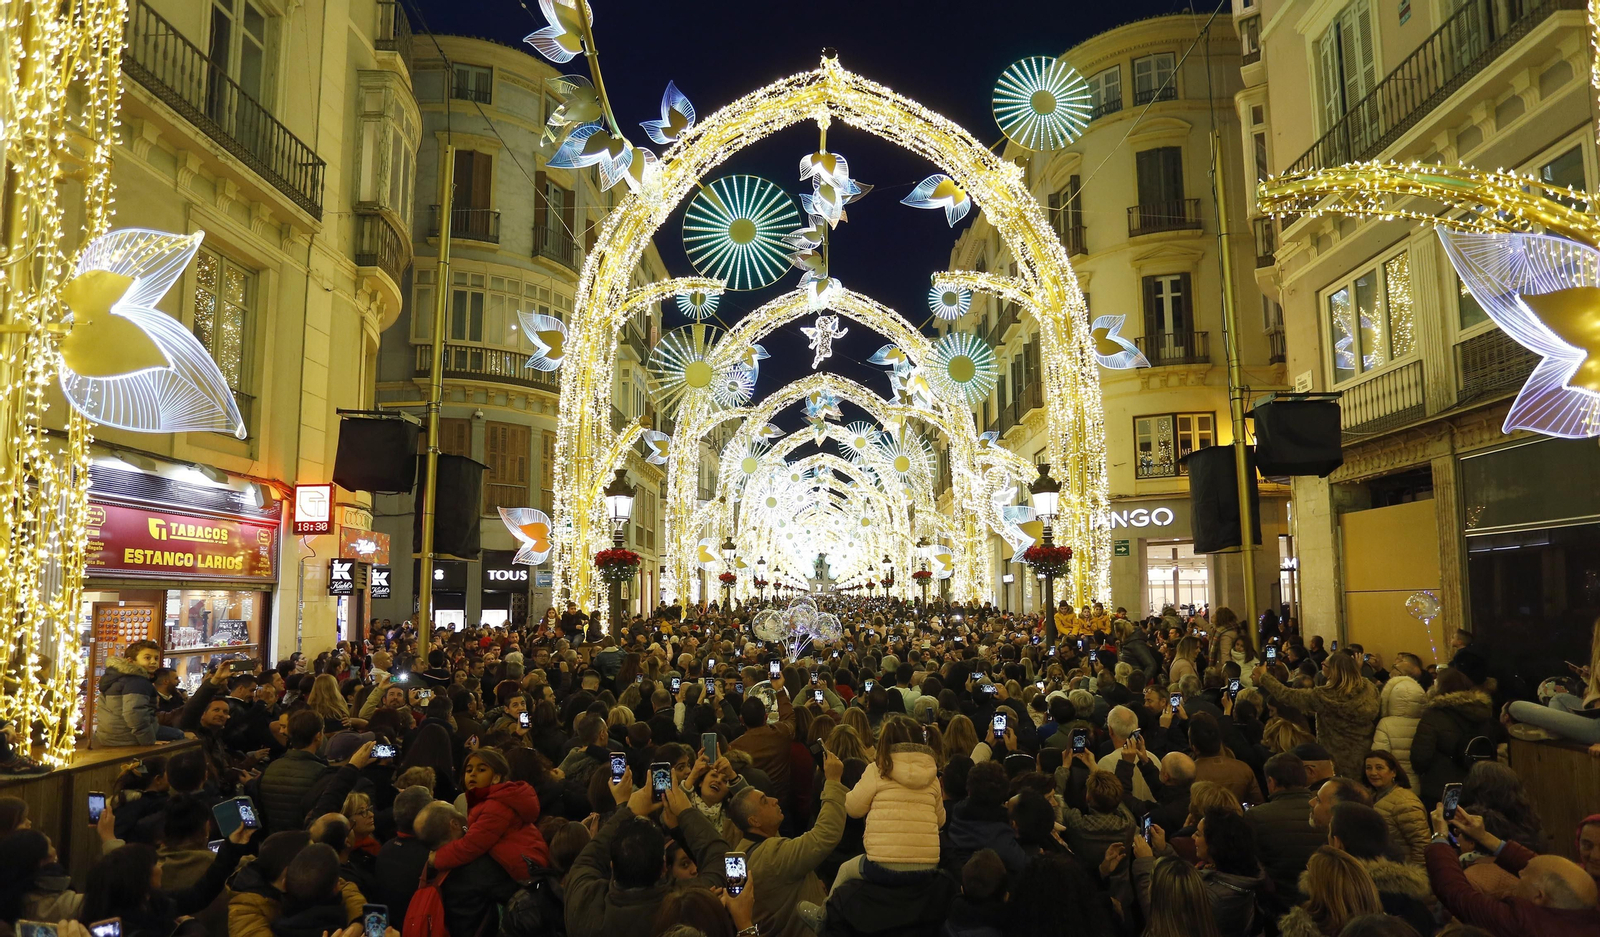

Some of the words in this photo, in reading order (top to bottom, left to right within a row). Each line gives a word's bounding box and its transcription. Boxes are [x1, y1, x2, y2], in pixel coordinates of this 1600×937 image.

[169, 522, 229, 541] TABACOS
[297, 522, 328, 532] 18:30
[124, 548, 194, 567] ESTANCO
[197, 554, 244, 570] LARIOS
[487, 570, 528, 581] TOUS
